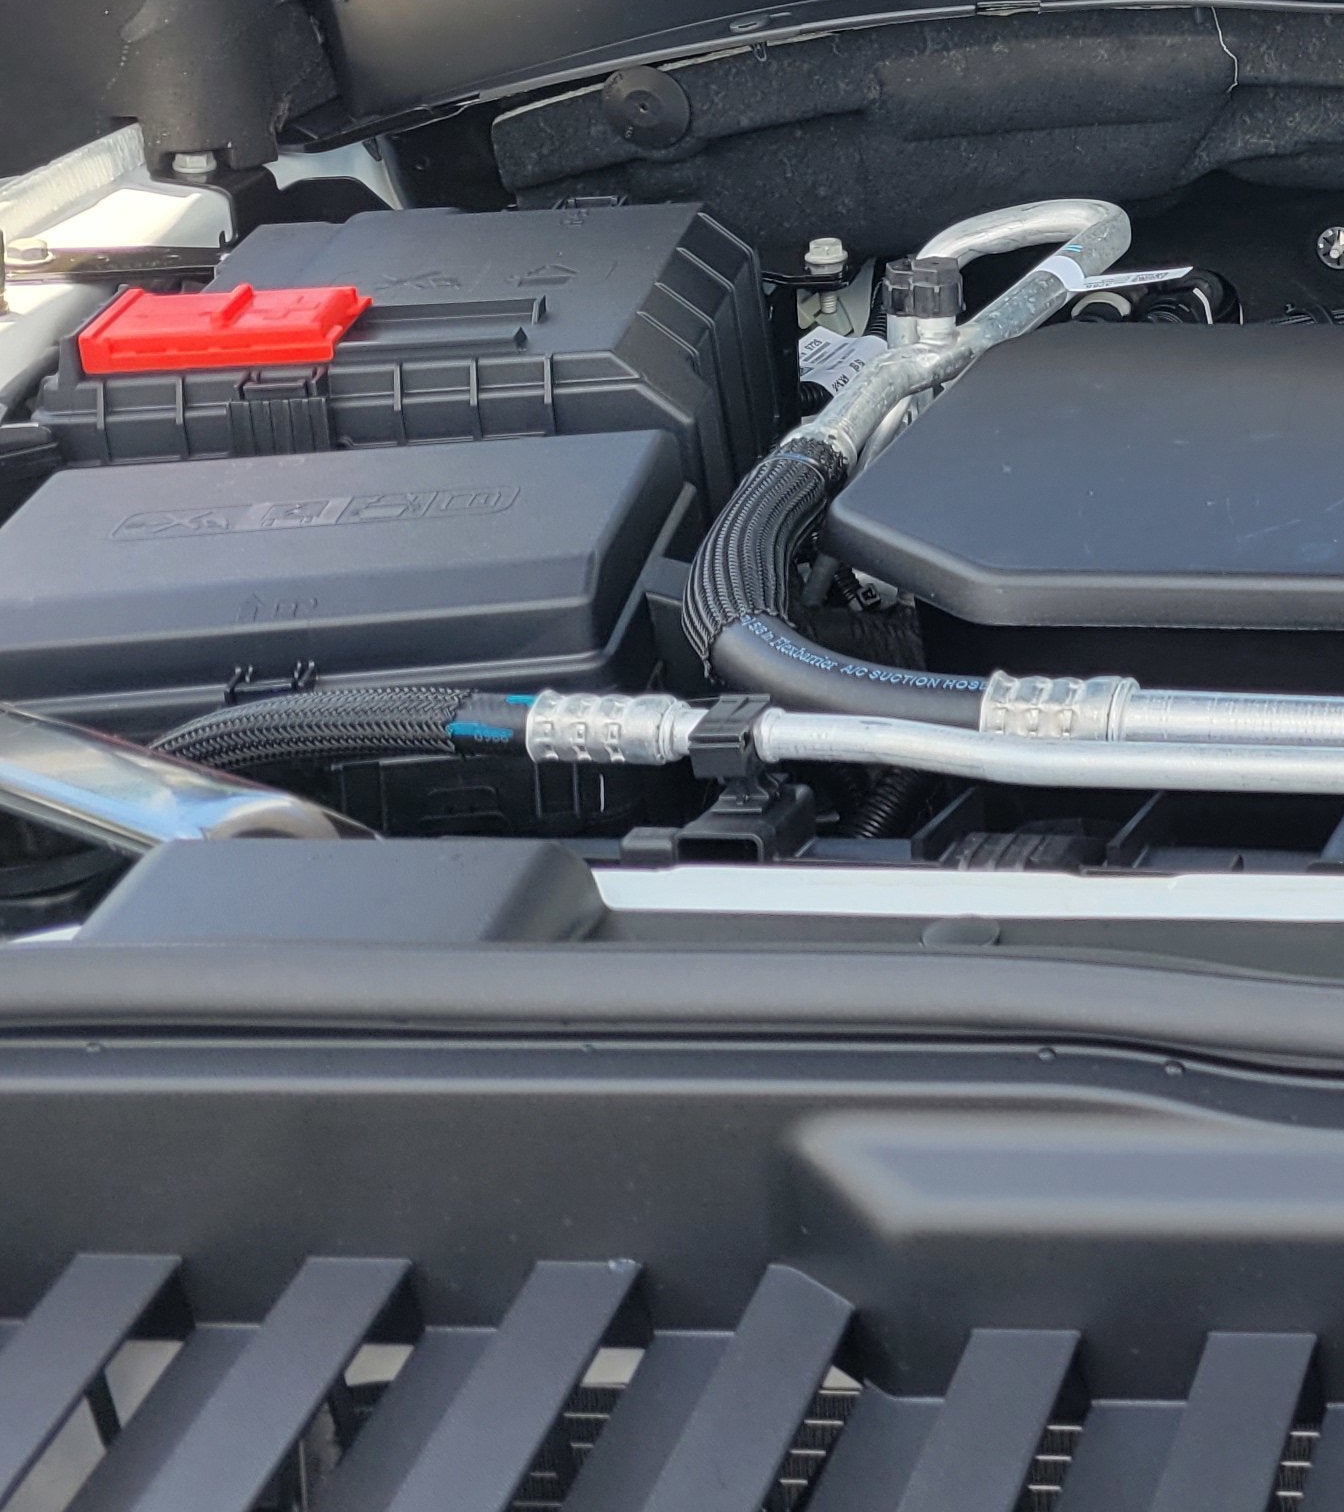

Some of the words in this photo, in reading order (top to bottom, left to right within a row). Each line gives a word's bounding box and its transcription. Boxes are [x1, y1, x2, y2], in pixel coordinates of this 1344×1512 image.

[769, 636, 838, 671] Flexbarrier
[839, 664, 868, 677] A/C
[868, 670, 941, 689] SUCTION
